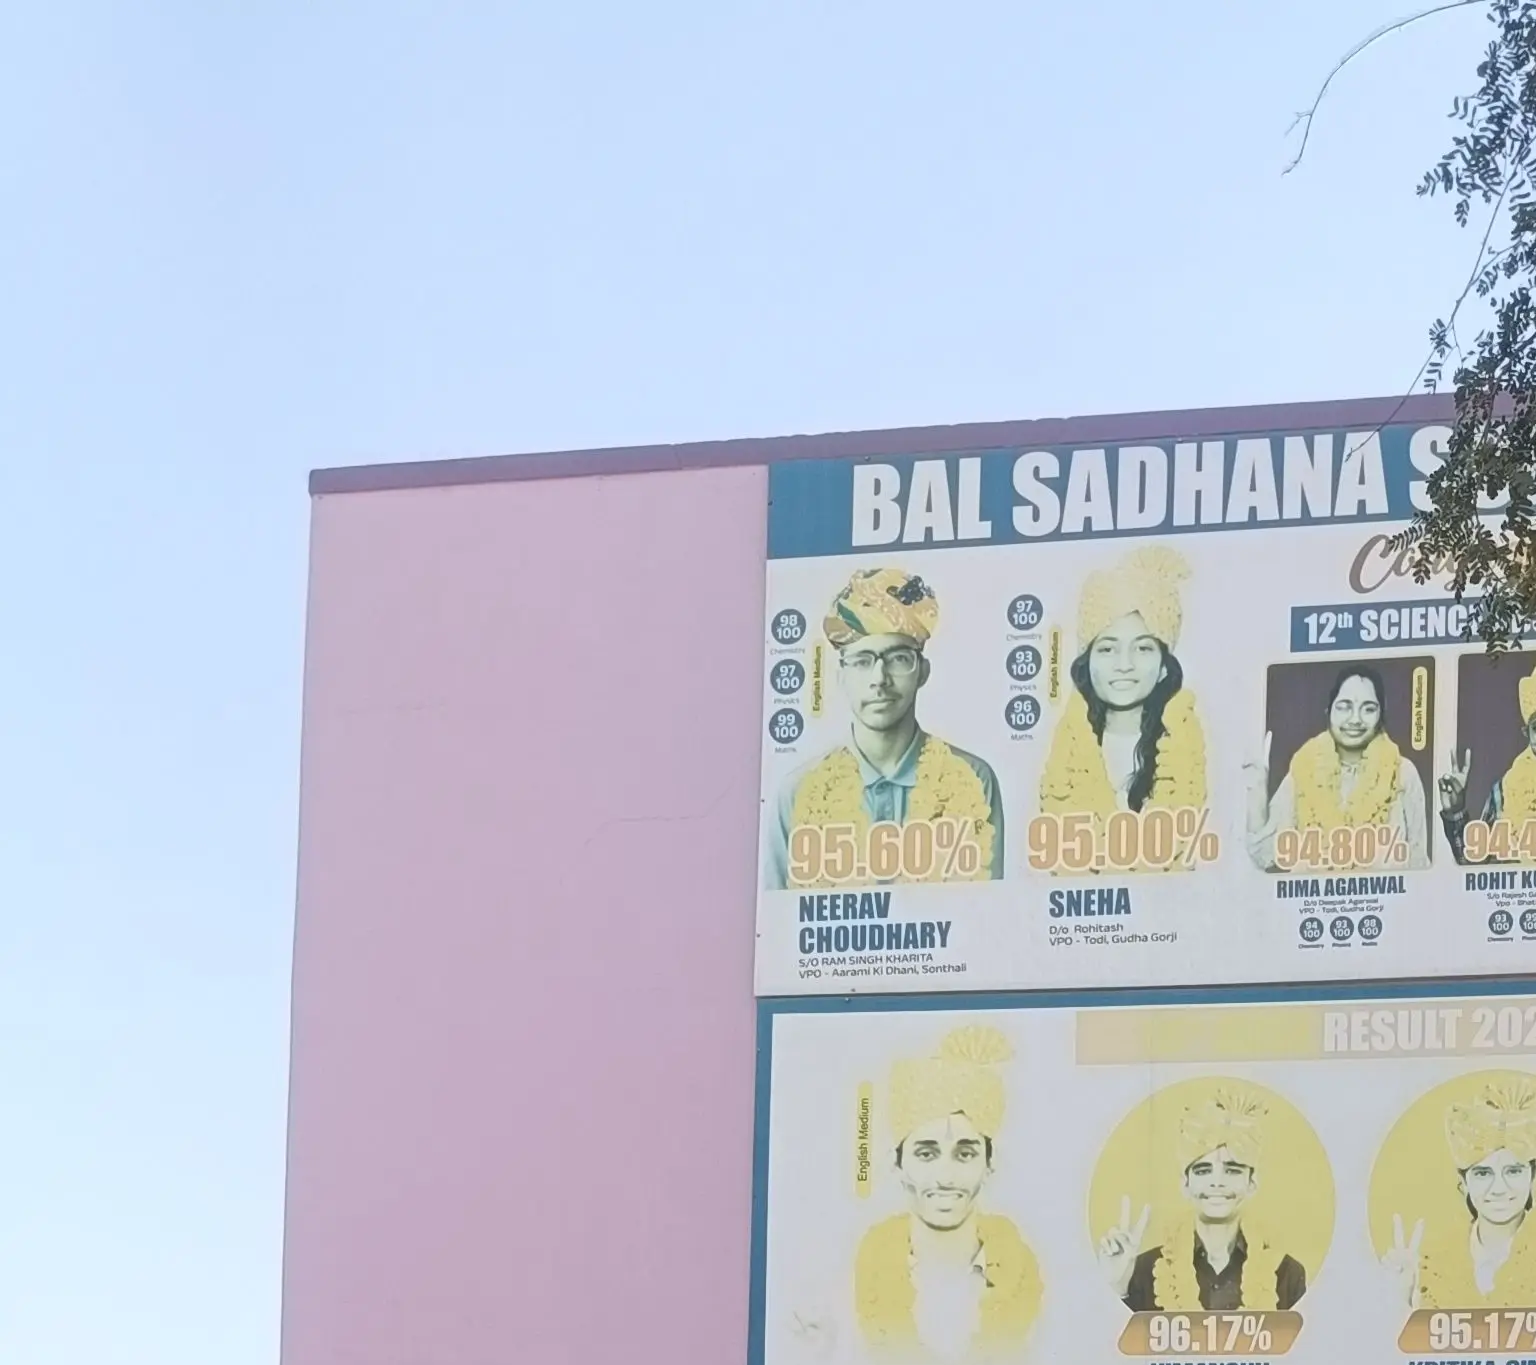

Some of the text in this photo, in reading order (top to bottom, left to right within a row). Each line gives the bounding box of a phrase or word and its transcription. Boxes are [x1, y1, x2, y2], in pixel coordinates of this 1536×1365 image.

[852, 457, 992, 547] BAL
[1012, 430, 1389, 537] SADHANA
[1016, 601, 1033, 612] 97
[780, 615, 798, 626] 98
[1013, 613, 1038, 625] 100
[776, 627, 801, 639] 100
[1303, 612, 1353, 645] 12th
[1015, 652, 1033, 663] 93
[780, 666, 796, 677] 97
[1012, 664, 1036, 675] 100
[775, 676, 799, 688] 100
[1014, 701, 1032, 713] 96
[1414, 673, 1424, 743] English Medium
[777, 714, 795, 725] 99
[1010, 714, 1035, 725] 100
[774, 726, 798, 738] 100
[1028, 808, 1219, 869] 95.00%
[790, 821, 978, 878] 95.60%
[1276, 826, 1408, 868] 94.80%
[1277, 875, 1406, 898] RIMA AGARWAL
[1465, 872, 1518, 891] ROHIT
[799, 892, 891, 922] NEERAV
[1049, 887, 1131, 918] SNEHA
[1049, 923, 1123, 935] D/o Rohitash
[799, 921, 951, 954] CHOUDHARY
[1049, 936, 1072, 946] VPO
[1112, 933, 1148, 944] Gudha
[1151, 931, 1177, 943] Gorji
[799, 953, 933, 968] S/O RAM SINGH KHARITA
[799, 969, 822, 979] VPO
[1323, 1008, 1462, 1052] RESULT
[858, 1097, 869, 1182] English Medium
[1148, 1314, 1272, 1353] 96.17%
